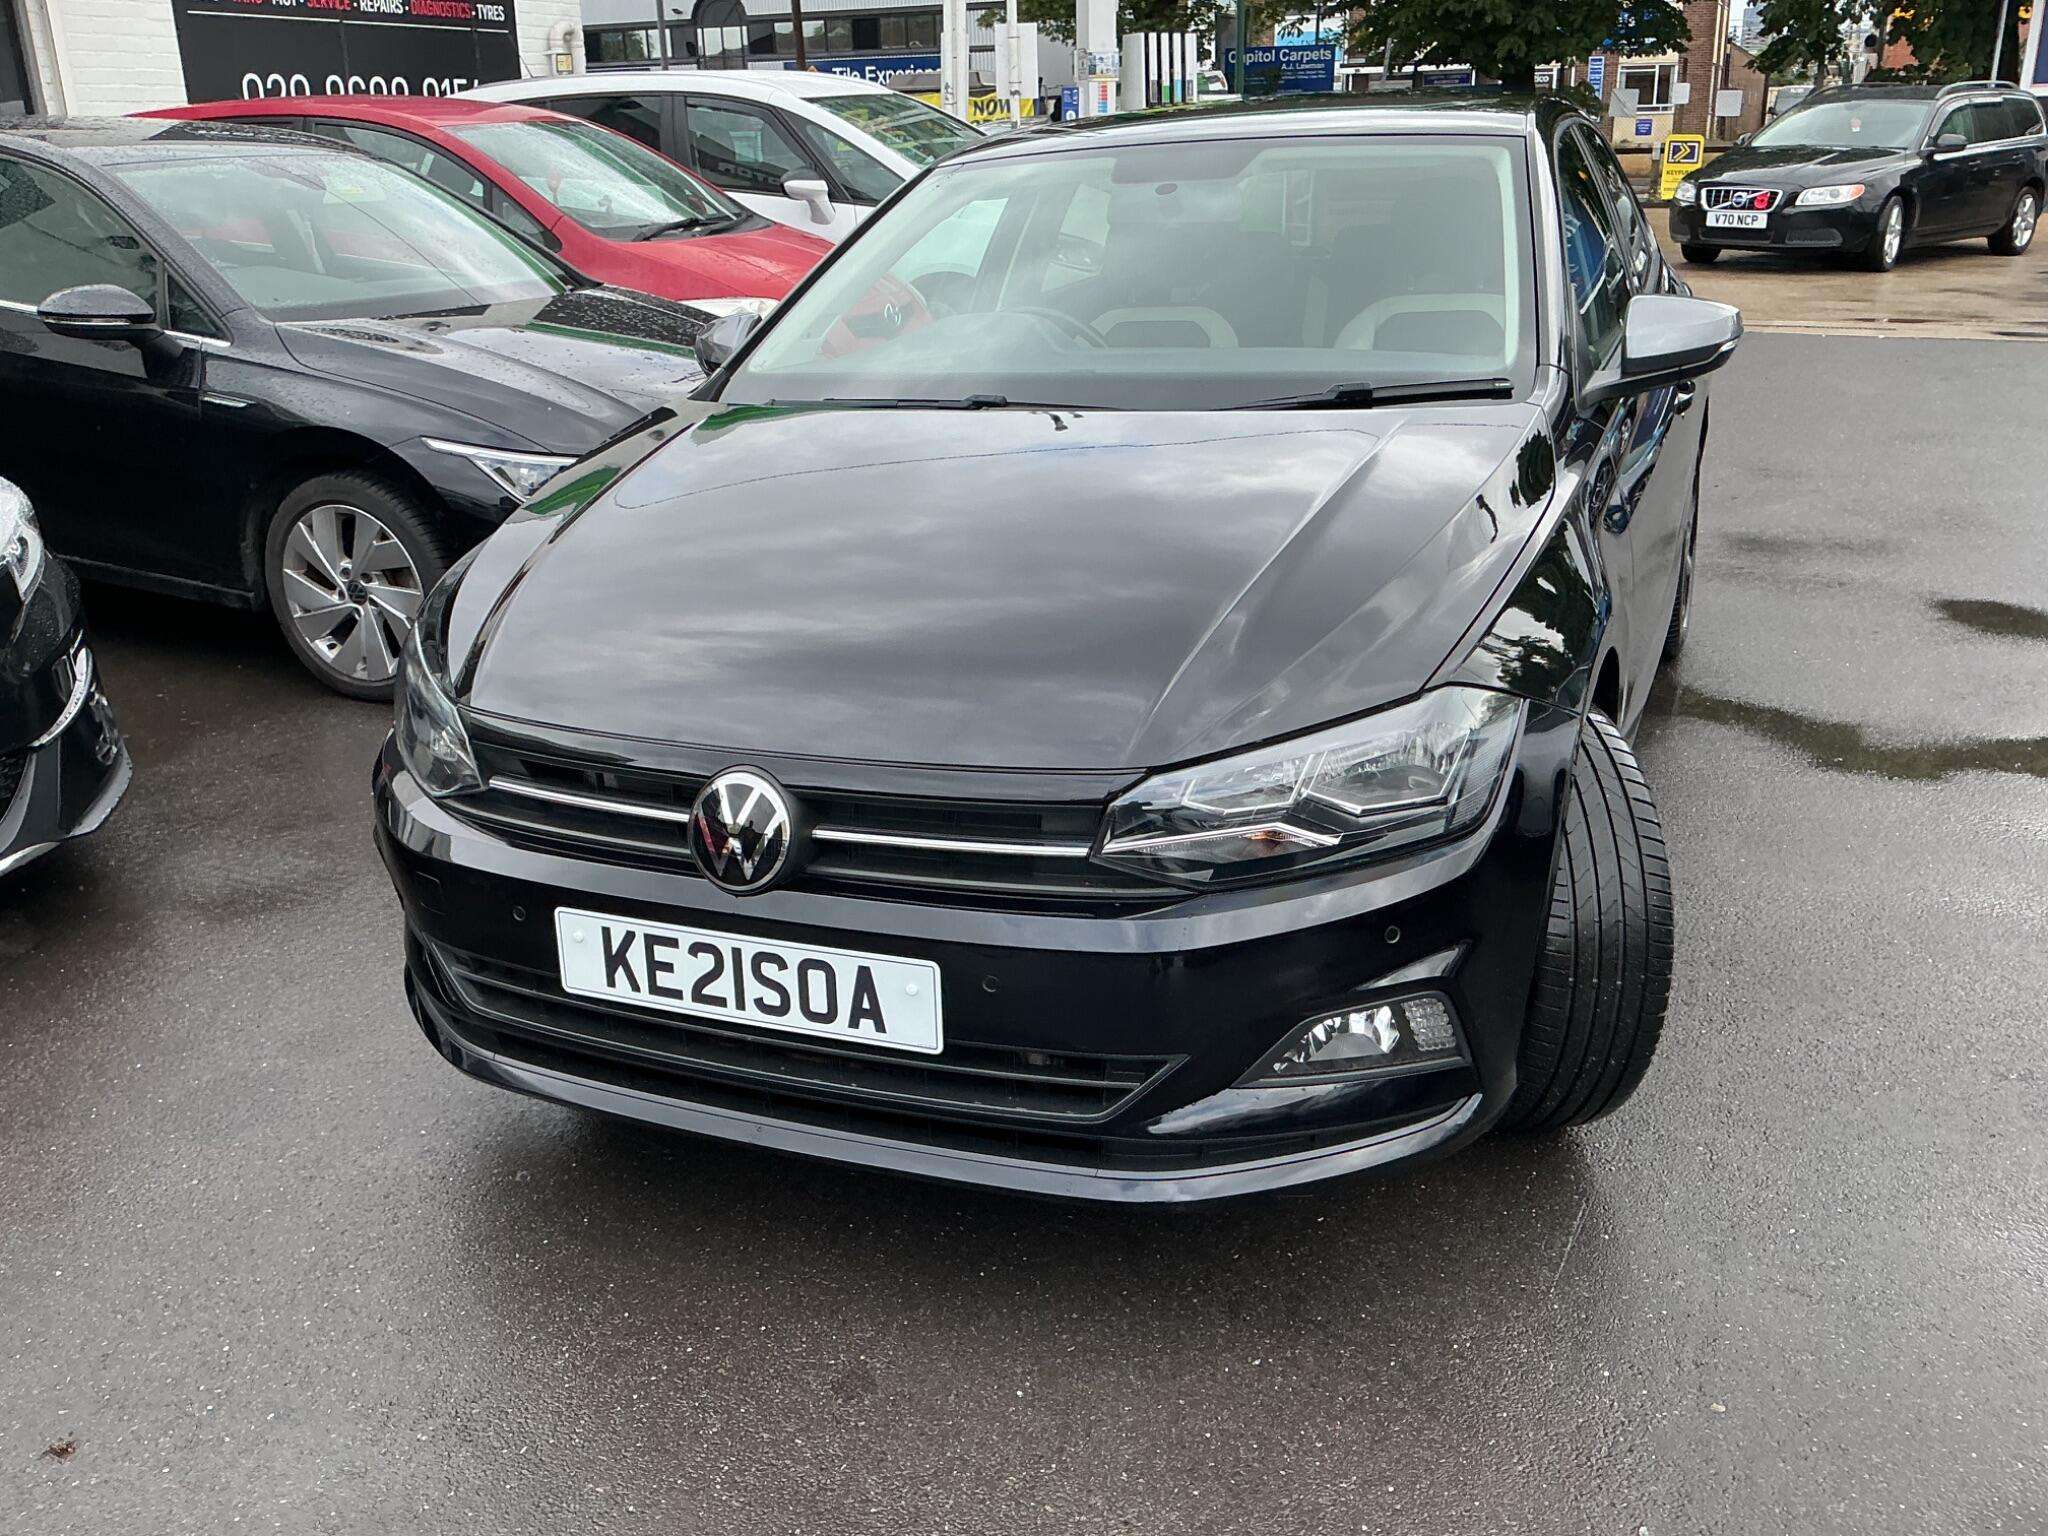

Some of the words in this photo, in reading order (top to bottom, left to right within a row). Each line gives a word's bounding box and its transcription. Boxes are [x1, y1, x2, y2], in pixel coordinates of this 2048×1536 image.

[360, 0, 403, 13] REPAIRS
[410, 0, 471, 19] DIAGNOSTICS
[477, 4, 505, 21] TYRES
[1279, 48, 1332, 63] Carpets
[1714, 213, 1735, 225] V70
[1736, 214, 1759, 226] NCP
[601, 925, 888, 1035] KE21SOA
